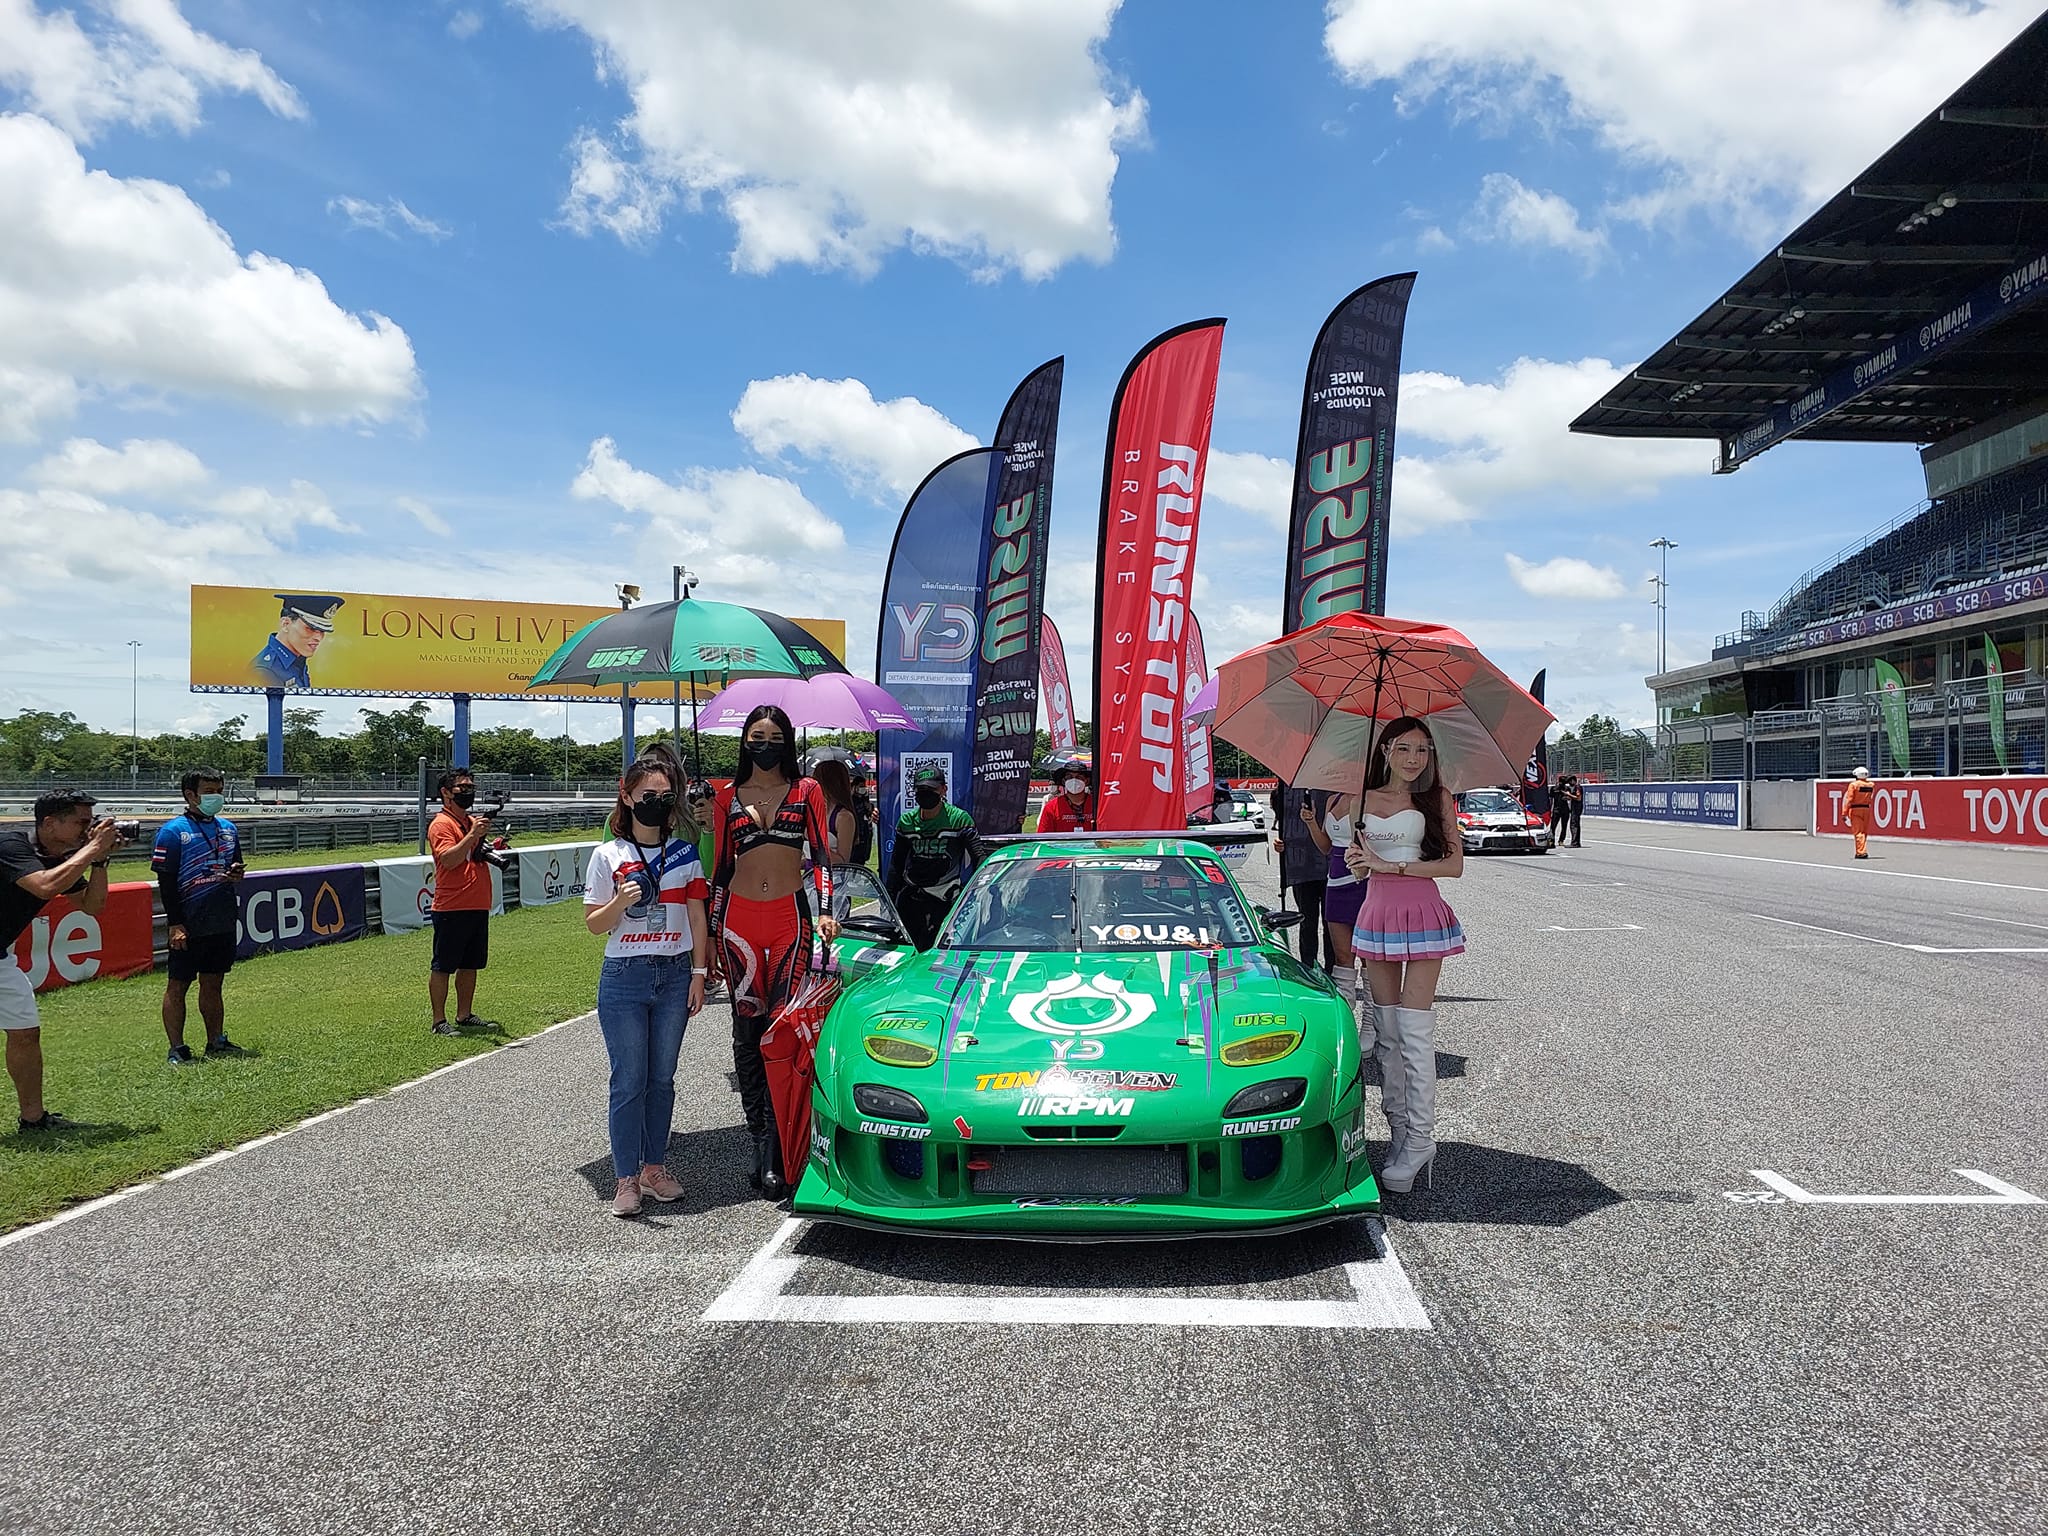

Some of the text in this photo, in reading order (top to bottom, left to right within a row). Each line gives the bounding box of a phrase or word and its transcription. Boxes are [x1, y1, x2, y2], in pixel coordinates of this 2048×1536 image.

[1930, 302, 1972, 339] YAMAHA
[1863, 345, 1897, 378] YAMAHA
[1796, 387, 1825, 415] YAMAHA
[2004, 580, 2031, 602] SCB
[1913, 603, 1934, 622] SCB
[1955, 594, 1979, 613] SCB
[362, 608, 575, 644] LONG LIVE
[1104, 449, 1141, 797] BRAKE SYSTEM
[1141, 441, 1197, 794] RUNSTOP
[1874, 614, 1894, 632] SCB
[1808, 629, 1825, 646] SCB
[1840, 624, 1858, 639] SCB
[419, 653, 491, 665] MANAGEMENT
[495, 656, 517, 665] AND
[468, 646, 550, 657] WITH THE MOST
[586, 648, 648, 669] WISE
[699, 646, 757, 664] WISE
[887, 674, 908, 682] DIETARY
[910, 675, 944, 683] SUPPLEMENT
[1649, 792, 1668, 808] YAMAHA
[1677, 791, 1699, 810] YAMAHA
[1711, 792, 1736, 811] YAMAHA
[1829, 789, 1926, 830] TOTA
[1203, 866, 1226, 884] 5
[547, 884, 564, 899] SAT
[236, 888, 304, 946] CB
[1089, 924, 1210, 945] YOU&I
[874, 1018, 929, 1031] WISE
[1233, 1014, 1286, 1027] WISE
[975, 1069, 1180, 1092] TON SEVEN
[860, 1121, 932, 1140] RUNSTOP
[1222, 1116, 1301, 1137] RUNSTOP
